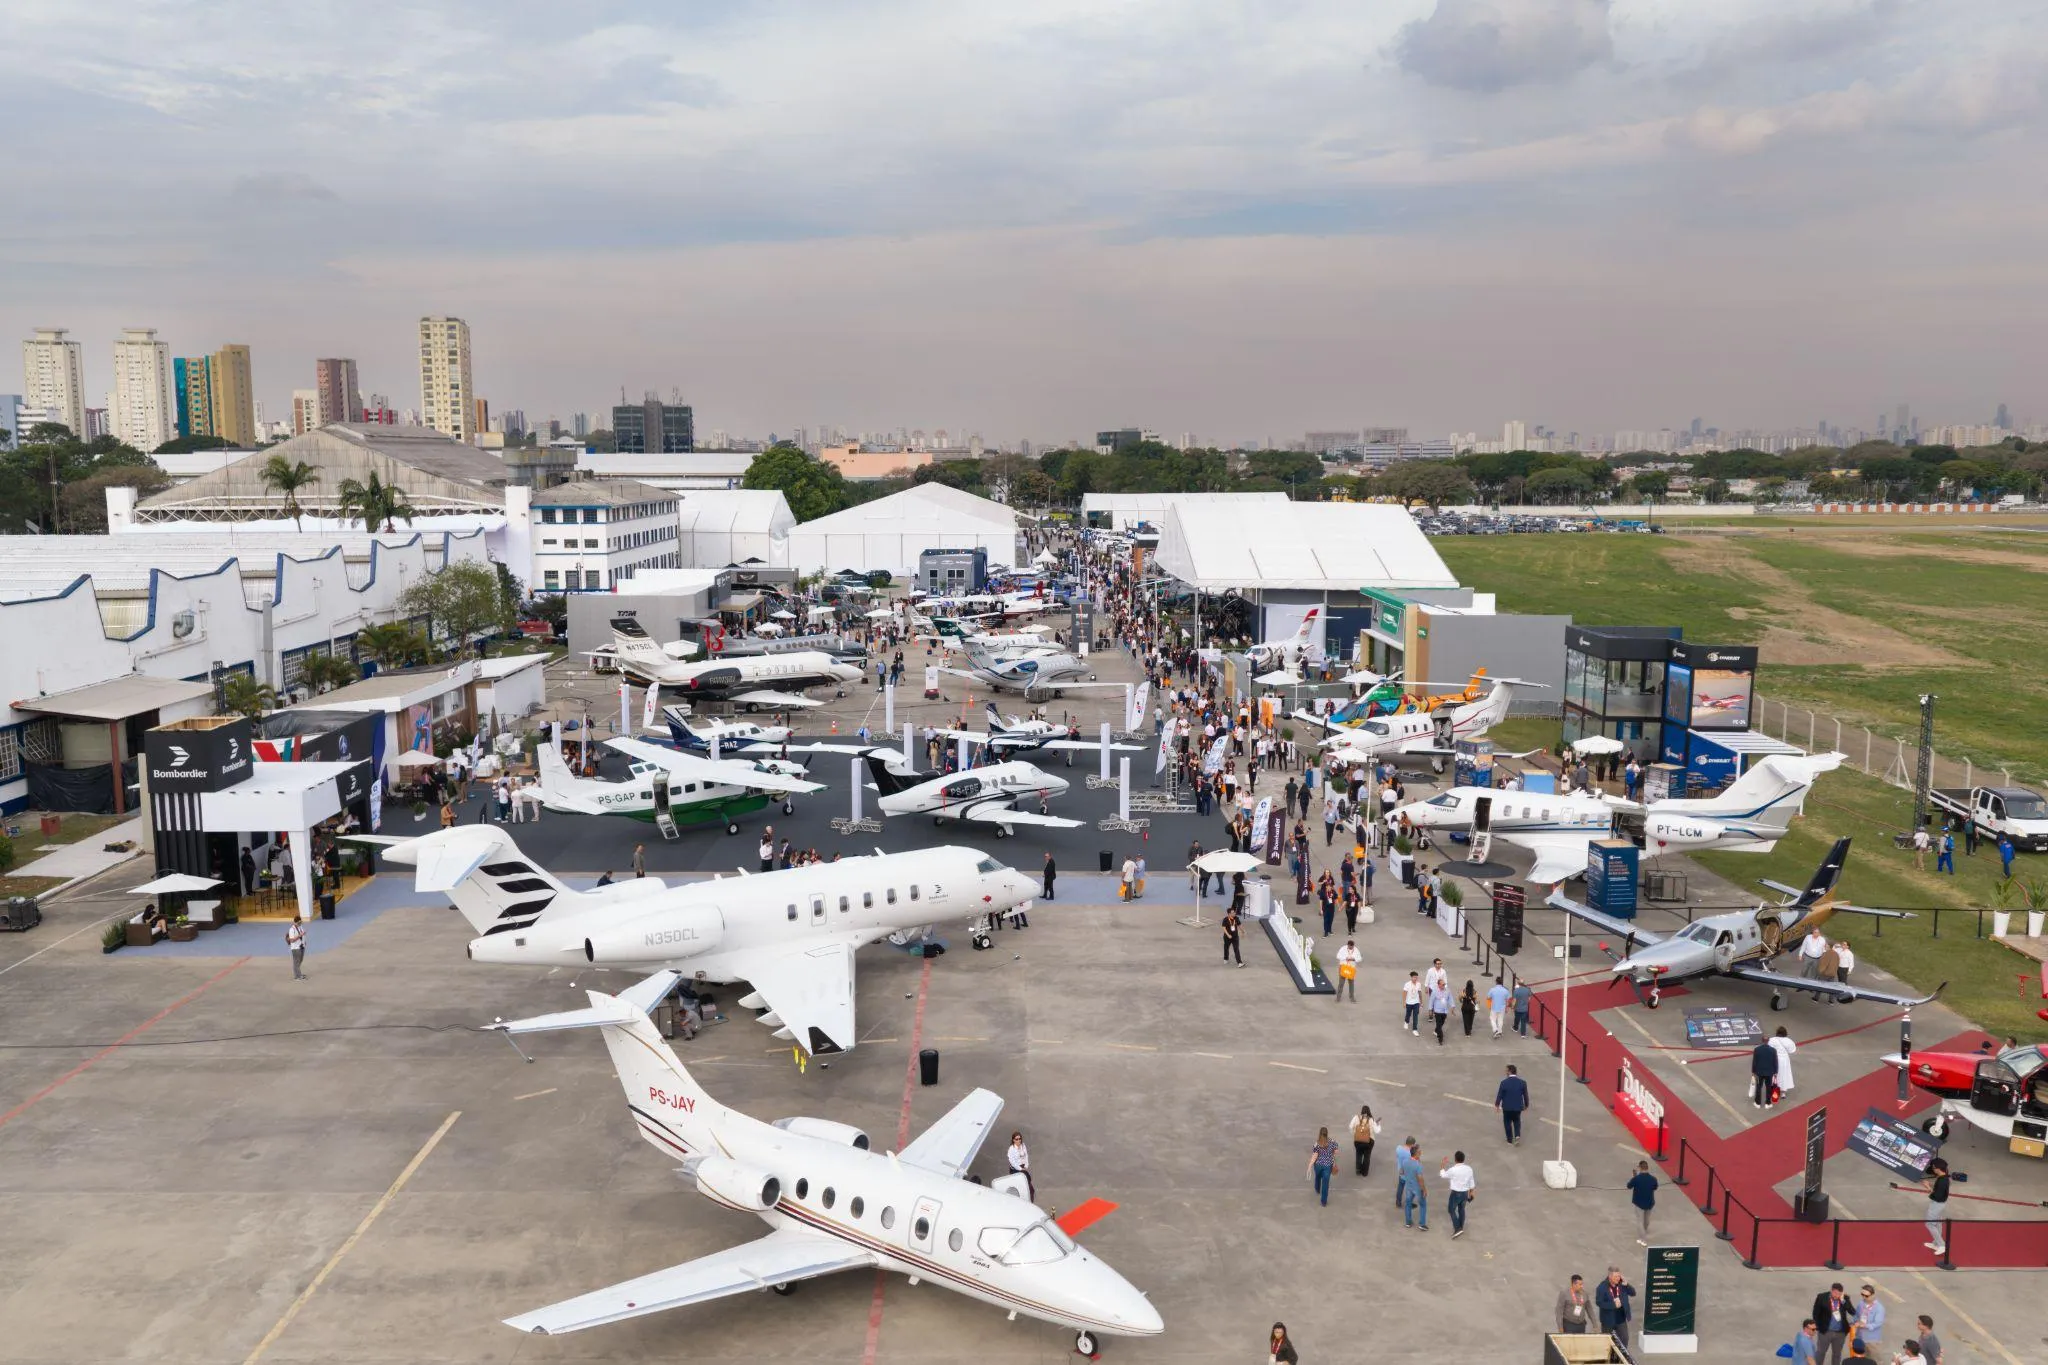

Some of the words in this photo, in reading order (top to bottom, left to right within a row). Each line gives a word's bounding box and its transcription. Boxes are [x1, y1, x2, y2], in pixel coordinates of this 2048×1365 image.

[153, 769, 208, 778] Bombardier
[222, 758, 248, 775] Bombardier
[598, 792, 636, 805] PS-GAP
[1657, 824, 1703, 837] PT-LCM
[645, 928, 700, 946] N350CL
[649, 1086, 696, 1114] PS-JAY
[1623, 1068, 1665, 1129] DAHER
